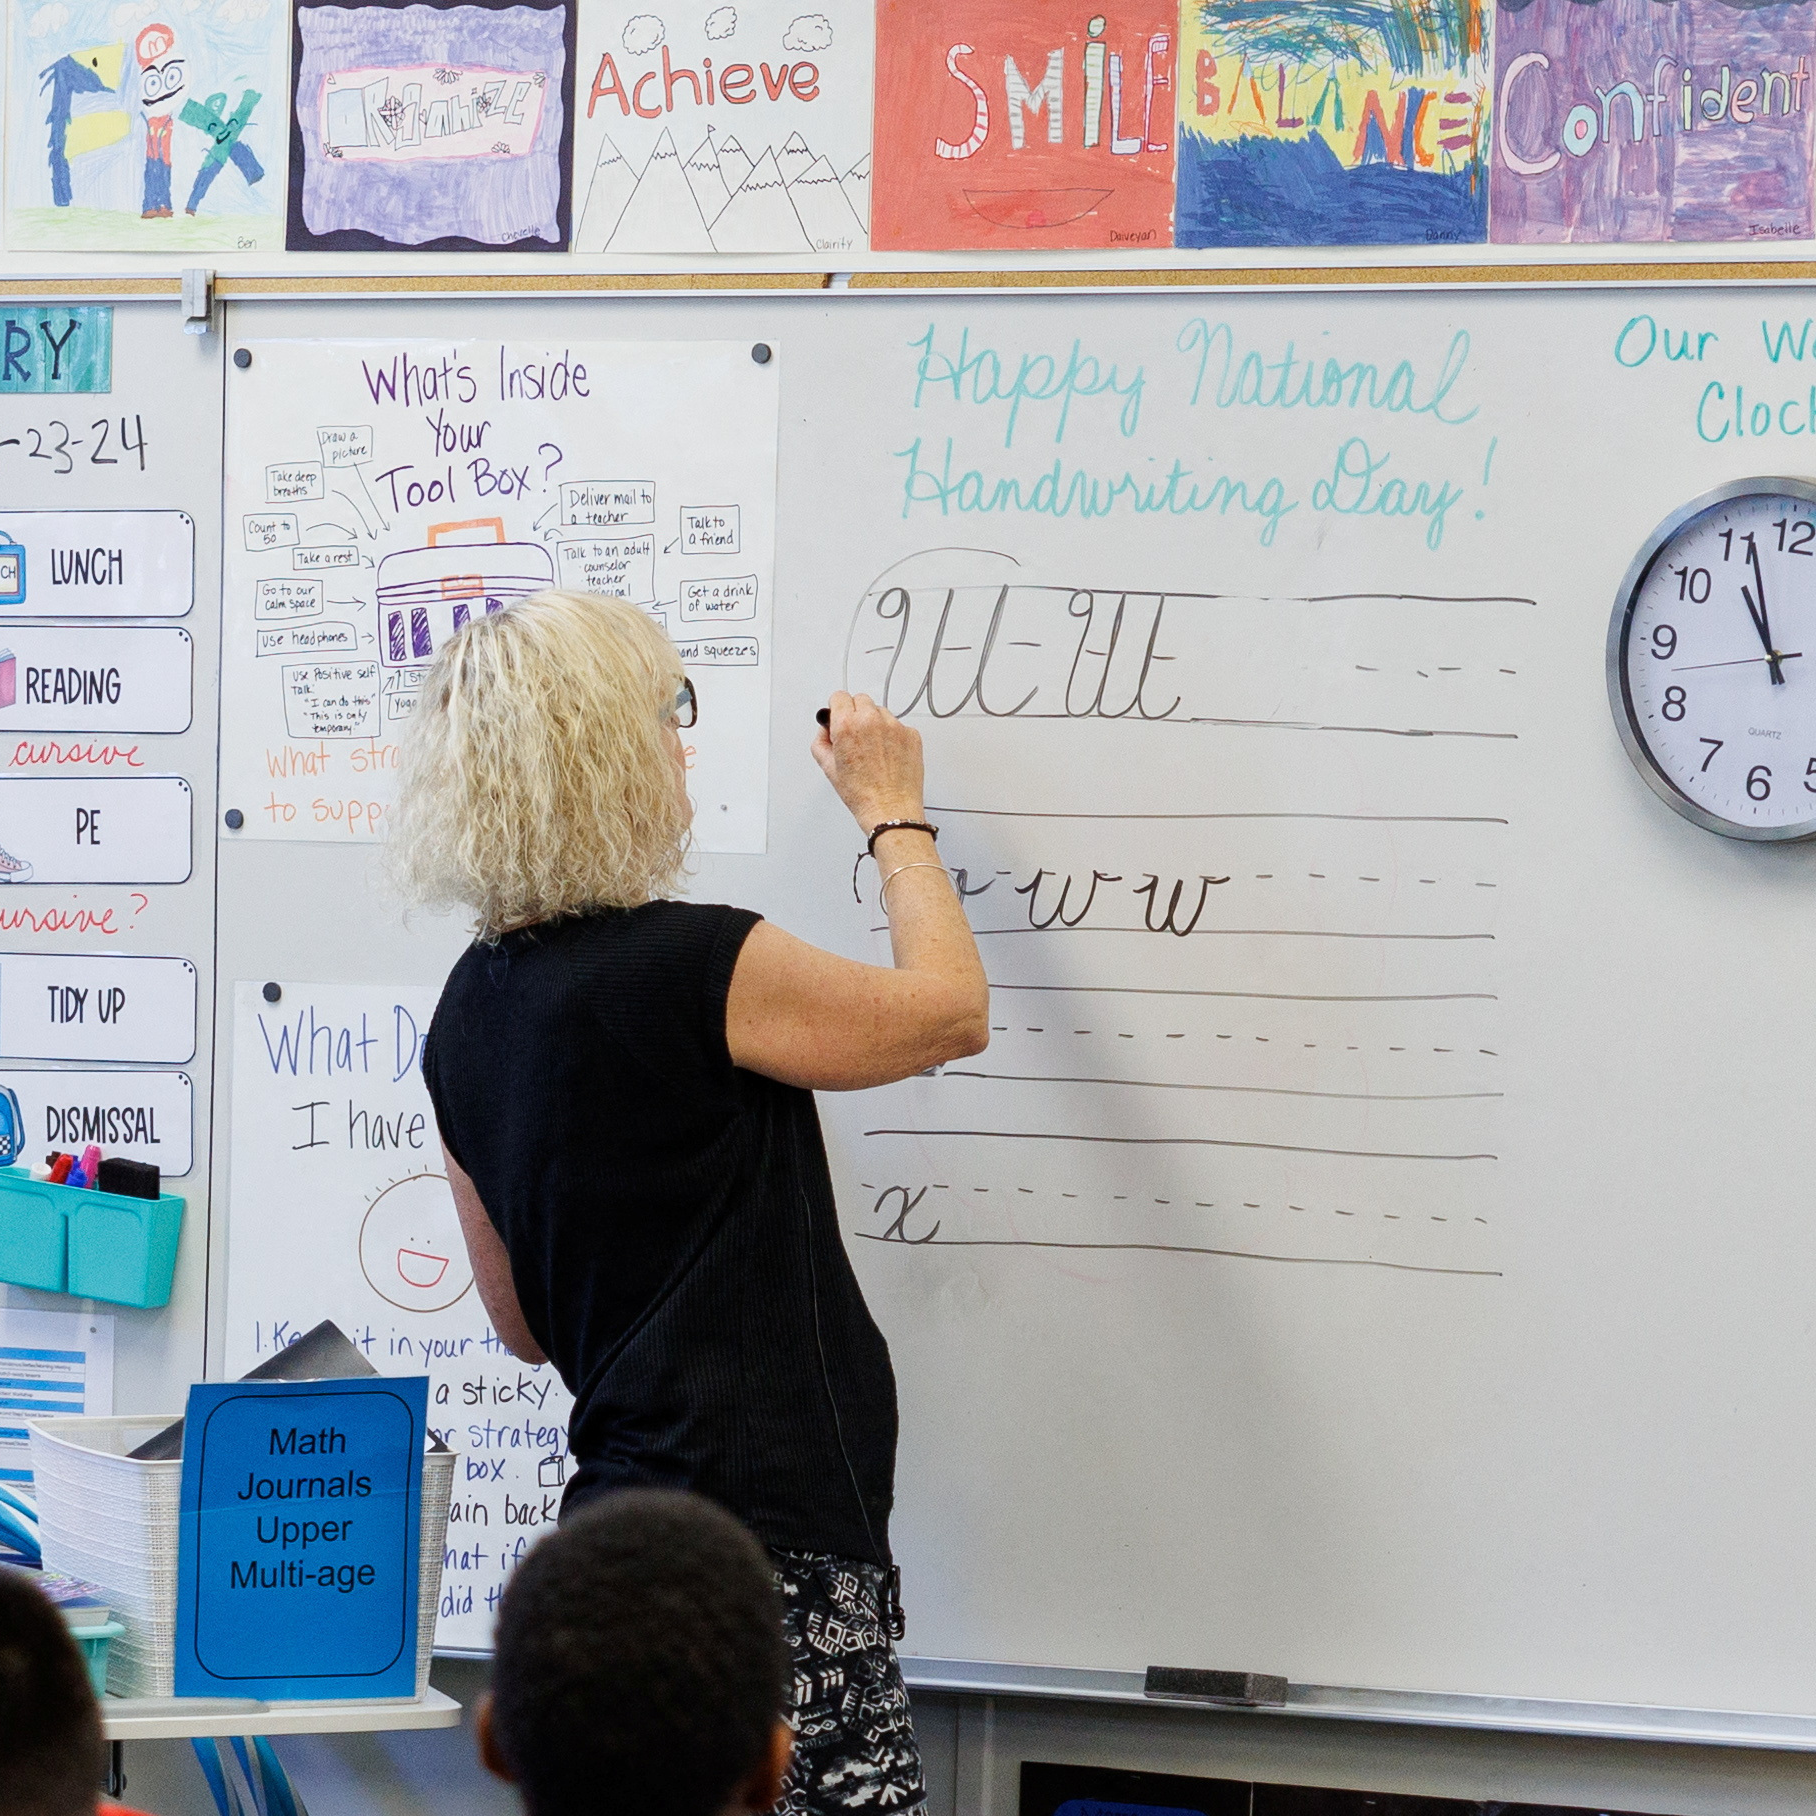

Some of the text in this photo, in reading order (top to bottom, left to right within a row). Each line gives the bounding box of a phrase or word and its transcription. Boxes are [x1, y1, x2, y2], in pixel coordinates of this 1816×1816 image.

[587, 45, 821, 121] Achieve
[1498, 51, 1811, 177] Confident
[1746, 223, 1801, 238] Isabelle
[1613, 314, 1719, 368] Our
[361, 345, 591, 408] What's Inside
[906, 317, 1481, 448] Happy National
[426, 408, 492, 457] Your
[375, 465, 457, 513] Tool
[569, 488, 636, 508] Deliver mail
[894, 436, 1498, 551] Handwriting Day!
[586, 511, 629, 524] teacher
[687, 516, 709, 529] Talk
[700, 529, 734, 546] friend
[1718, 528, 1757, 565] 11
[1772, 519, 1816, 556] 12
[51, 549, 123, 586] LUNCH
[1674, 566, 1712, 604] 10
[704, 643, 756, 660] squeezes
[1650, 624, 1678, 661] 9
[26, 667, 122, 705] READING
[1661, 686, 1688, 722] 8
[1747, 727, 1782, 740] QUARTZ
[9, 740, 145, 768] cursive
[1699, 737, 1724, 773] 7
[1746, 766, 1772, 801] 6
[76, 808, 102, 845] PE
[48, 986, 126, 1024] TIDY UP
[257, 1006, 379, 1076] What
[46, 1106, 161, 1146] DISMISSAL
[291, 1098, 426, 1151] I have
[269, 1426, 347, 1458] Math
[237, 1465, 372, 1502] Journals
[257, 1516, 353, 1550] Upper
[229, 1558, 377, 1594] Multi-age
